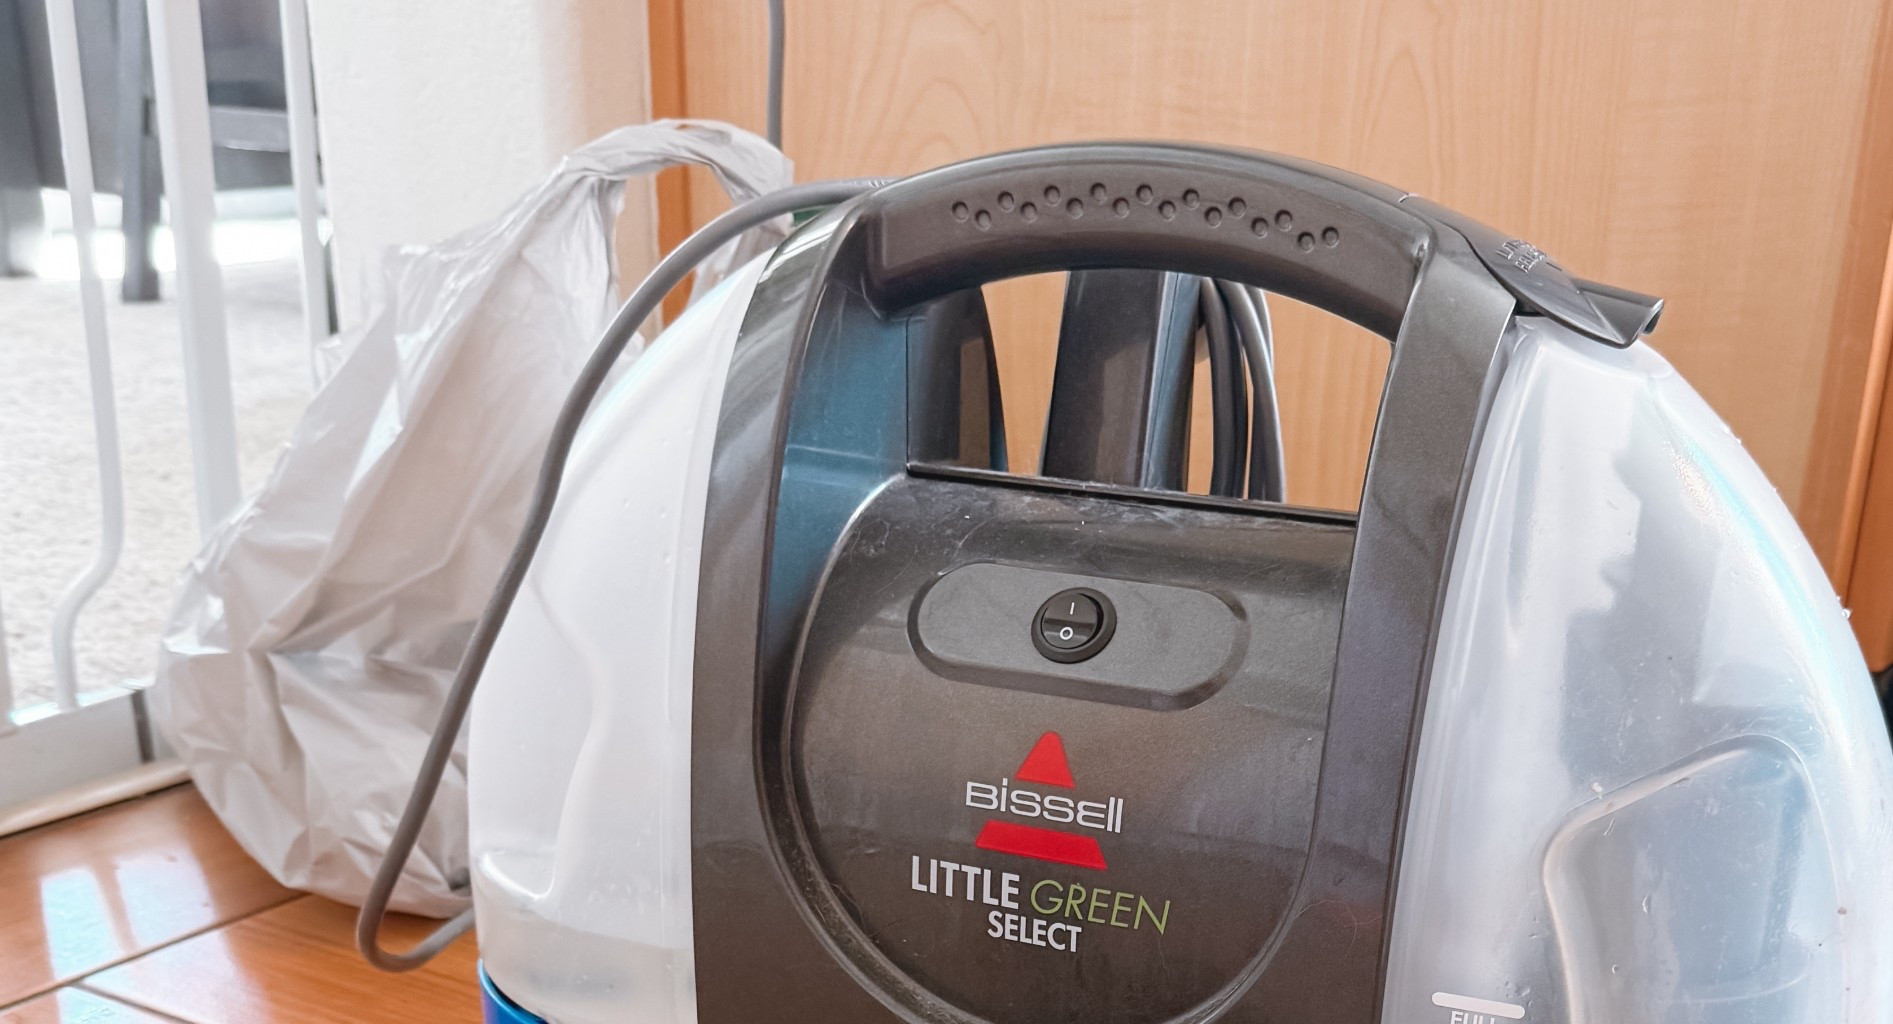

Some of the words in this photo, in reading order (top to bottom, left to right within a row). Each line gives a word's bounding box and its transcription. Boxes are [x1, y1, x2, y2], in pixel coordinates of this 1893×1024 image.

[911, 855, 1021, 909] LITTLE
[1030, 879, 1171, 935] GREEN
[987, 909, 1083, 953] SELECT
